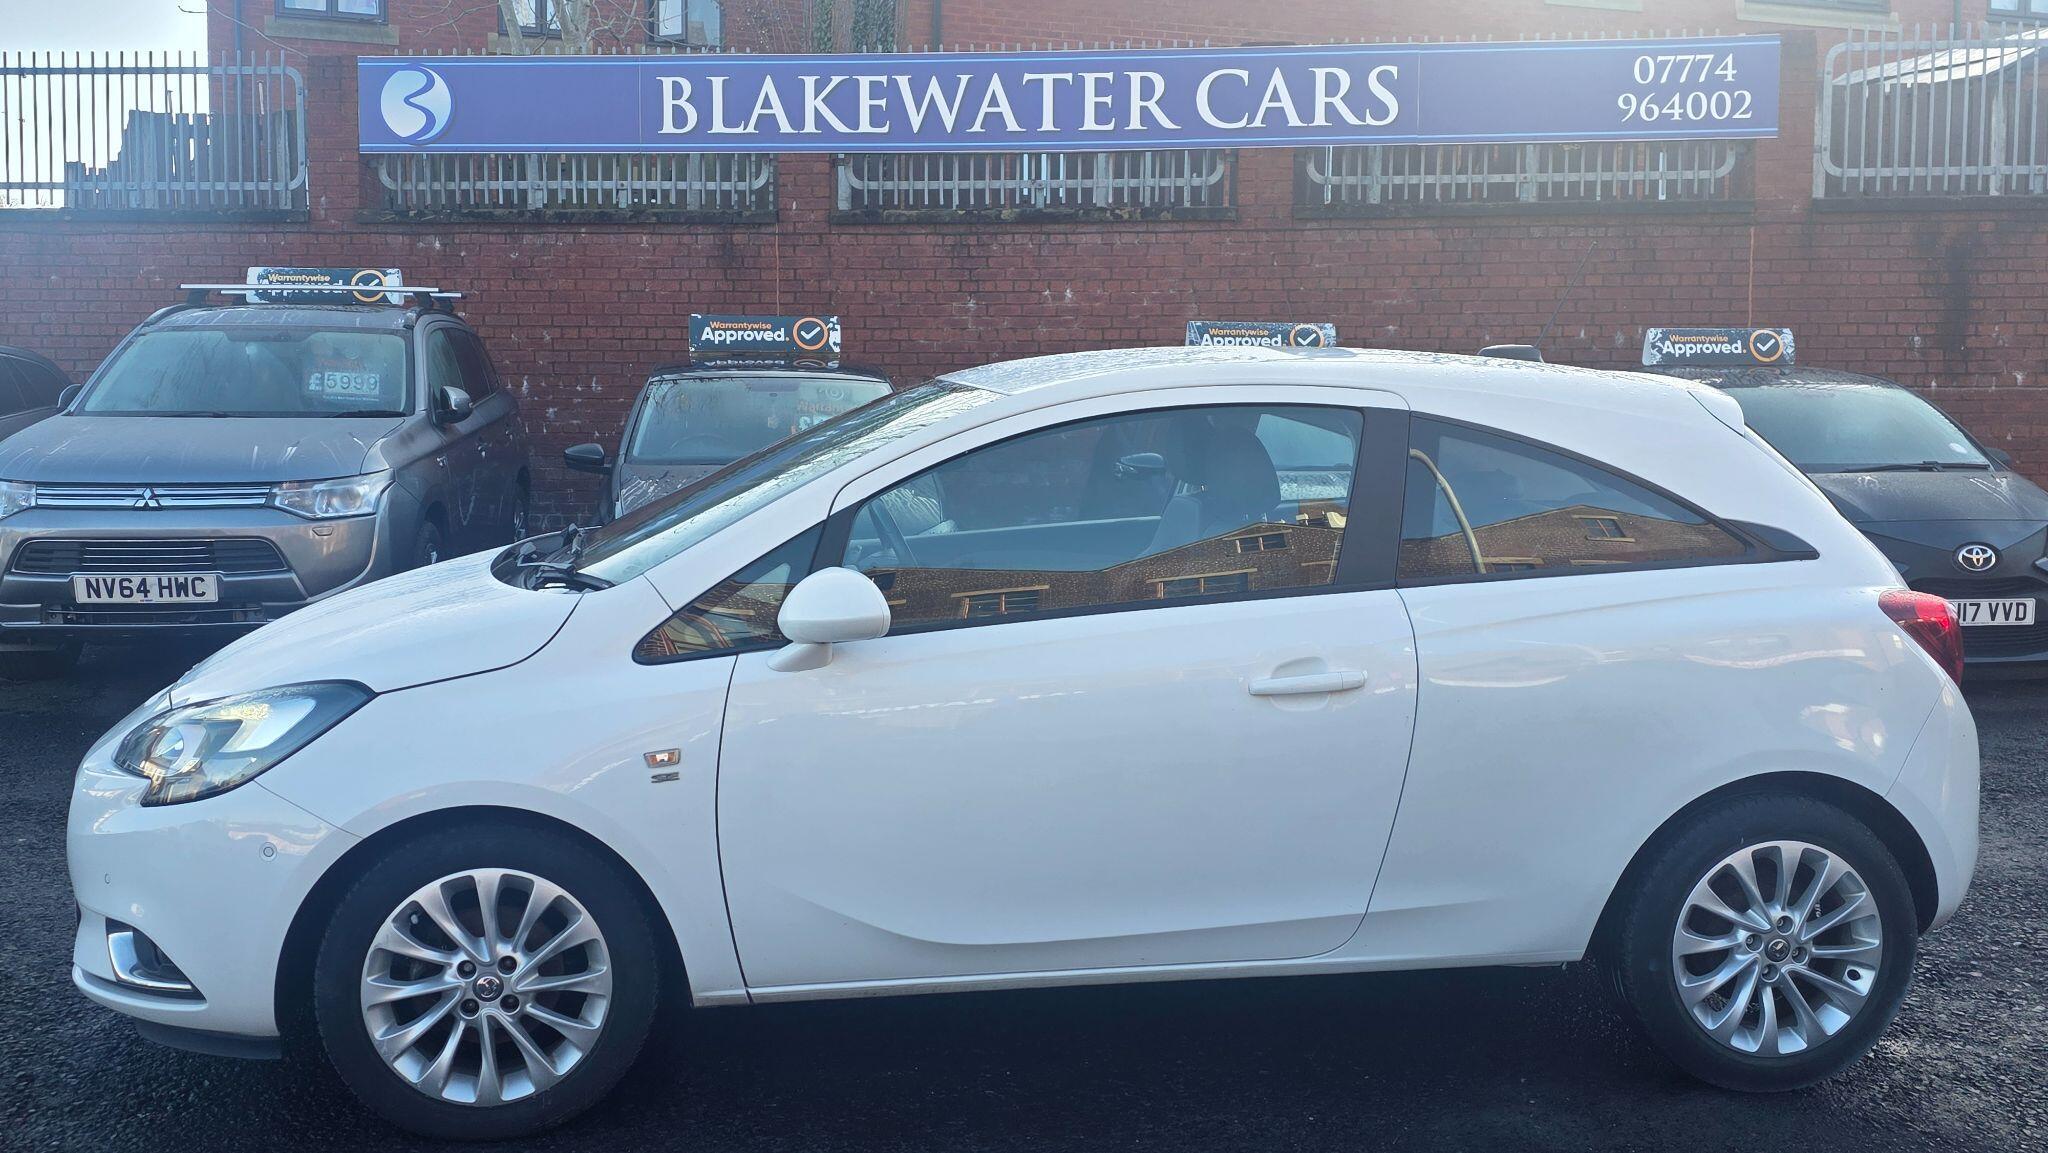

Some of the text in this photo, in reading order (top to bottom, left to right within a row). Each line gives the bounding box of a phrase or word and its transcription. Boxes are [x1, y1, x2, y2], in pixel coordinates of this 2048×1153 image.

[1633, 53, 1738, 84] 07774
[656, 65, 1399, 134] BLAKEWATER CARS
[1617, 90, 1753, 123] 964002
[267, 273, 331, 282] Warrantywise
[701, 326, 790, 345] Approved.
[709, 321, 772, 331] Warrantywise
[1208, 327, 1269, 337] Warrantywise
[1661, 339, 1747, 358] Approved.
[1669, 334, 1729, 344] Warrantywise
[85, 576, 207, 600] NV64 HWC
[1988, 602, 2028, 622] VVD
